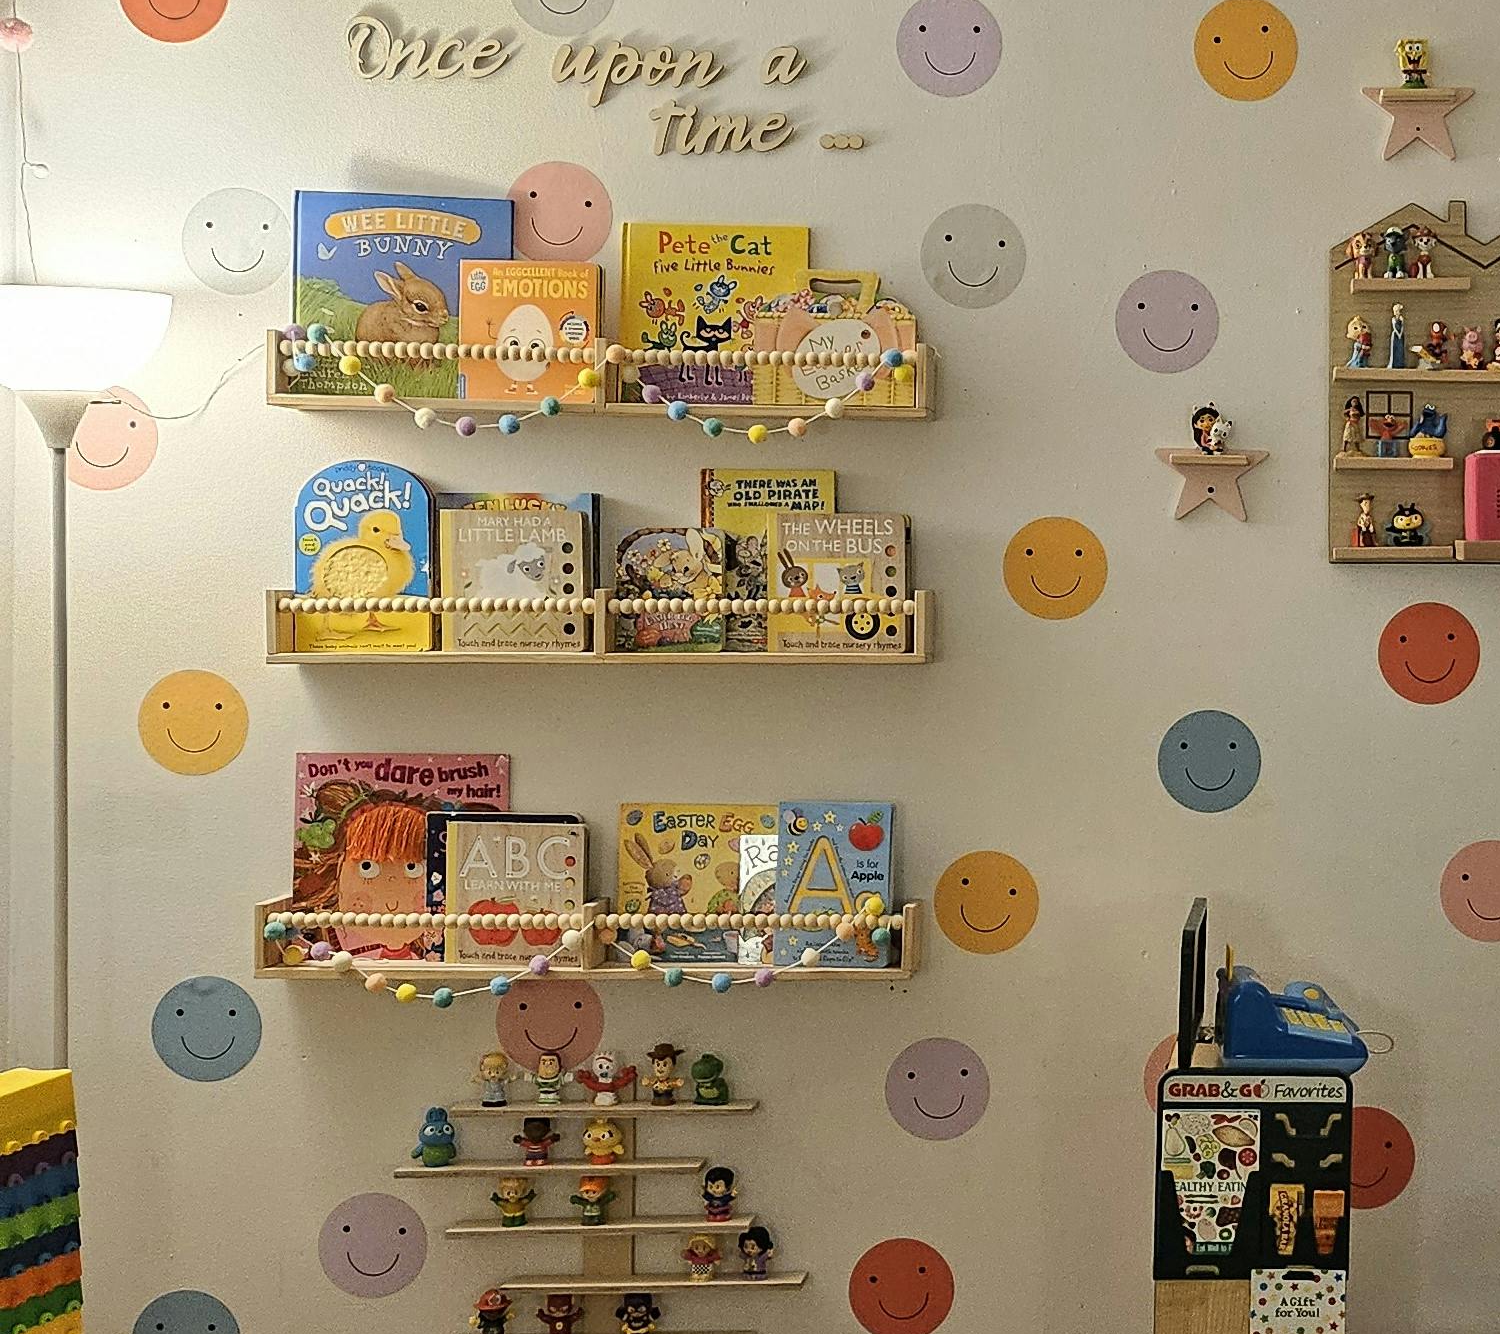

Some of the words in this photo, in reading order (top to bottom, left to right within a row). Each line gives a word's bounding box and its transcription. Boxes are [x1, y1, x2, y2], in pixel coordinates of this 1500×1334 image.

[348, 15, 511, 80] Once
[551, 40, 724, 108] upon
[761, 45, 808, 85] a
[649, 99, 794, 156] time
[341, 213, 387, 234] WEE
[396, 212, 468, 239] LITTLE
[354, 236, 454, 260] BUNNY
[658, 231, 710, 255] Pete
[711, 233, 728, 244] the
[730, 234, 772, 256] Cat
[684, 258, 720, 272] Little
[726, 258, 774, 276] Bunnies
[470, 281, 486, 292] EGG
[492, 278, 588, 299] EMOTIONS
[808, 336, 834, 353] My
[300, 378, 368, 393] Thompson
[313, 471, 386, 500] Quack!
[736, 479, 772, 489] THERE
[775, 478, 798, 488] WAS
[800, 478, 817, 487] AN
[733, 490, 761, 501] OLD
[767, 488, 819, 500] PIRATE
[303, 480, 411, 532] Quack!
[790, 501, 825, 511] MAP!
[478, 517, 509, 527] MARY
[513, 517, 540, 527] HAD
[543, 517, 552, 526] A
[782, 522, 810, 535] THE
[814, 518, 893, 535] WHEELS
[458, 528, 514, 542] LITTLE
[520, 528, 567, 543] LAMB
[786, 540, 810, 551] ON
[812, 540, 841, 552] THE
[846, 538, 882, 554] BUS
[457, 638, 479, 648] Touch
[481, 638, 495, 647] and
[497, 639, 518, 648] trace
[519, 641, 550, 649] nursery
[552, 638, 581, 649] rhymes
[782, 639, 804, 649] Touch
[805, 640, 819, 648] and
[820, 640, 840, 648] trace
[842, 641, 872, 650] nursery
[873, 640, 902, 651] rhymes
[308, 758, 350, 778] Don't
[354, 759, 373, 771] you
[374, 758, 435, 786] dare
[438, 761, 490, 783] brush
[447, 786, 463, 798] my
[466, 783, 501, 798] hair!
[459, 835, 571, 879] ABC
[857, 858, 865, 868] is
[867, 858, 879, 868] for
[788, 835, 852, 914] A
[851, 871, 884, 882] Apple
[464, 880, 505, 890] LEARN
[506, 880, 540, 890] WITH
[545, 881, 561, 891] ME
[459, 949, 480, 960] Touch
[481, 950, 496, 959] and
[497, 950, 517, 960] trace
[1274, 1083, 1343, 1098] Favorites
[1174, 1181, 1214, 1192] EALTHY
[1218, 1181, 1247, 1192] EATIN
[1280, 1297, 1288, 1306] A
[1290, 1297, 1315, 1306] Gift
[1275, 1308, 1293, 1318] for
[1295, 1308, 1320, 1318] You!
